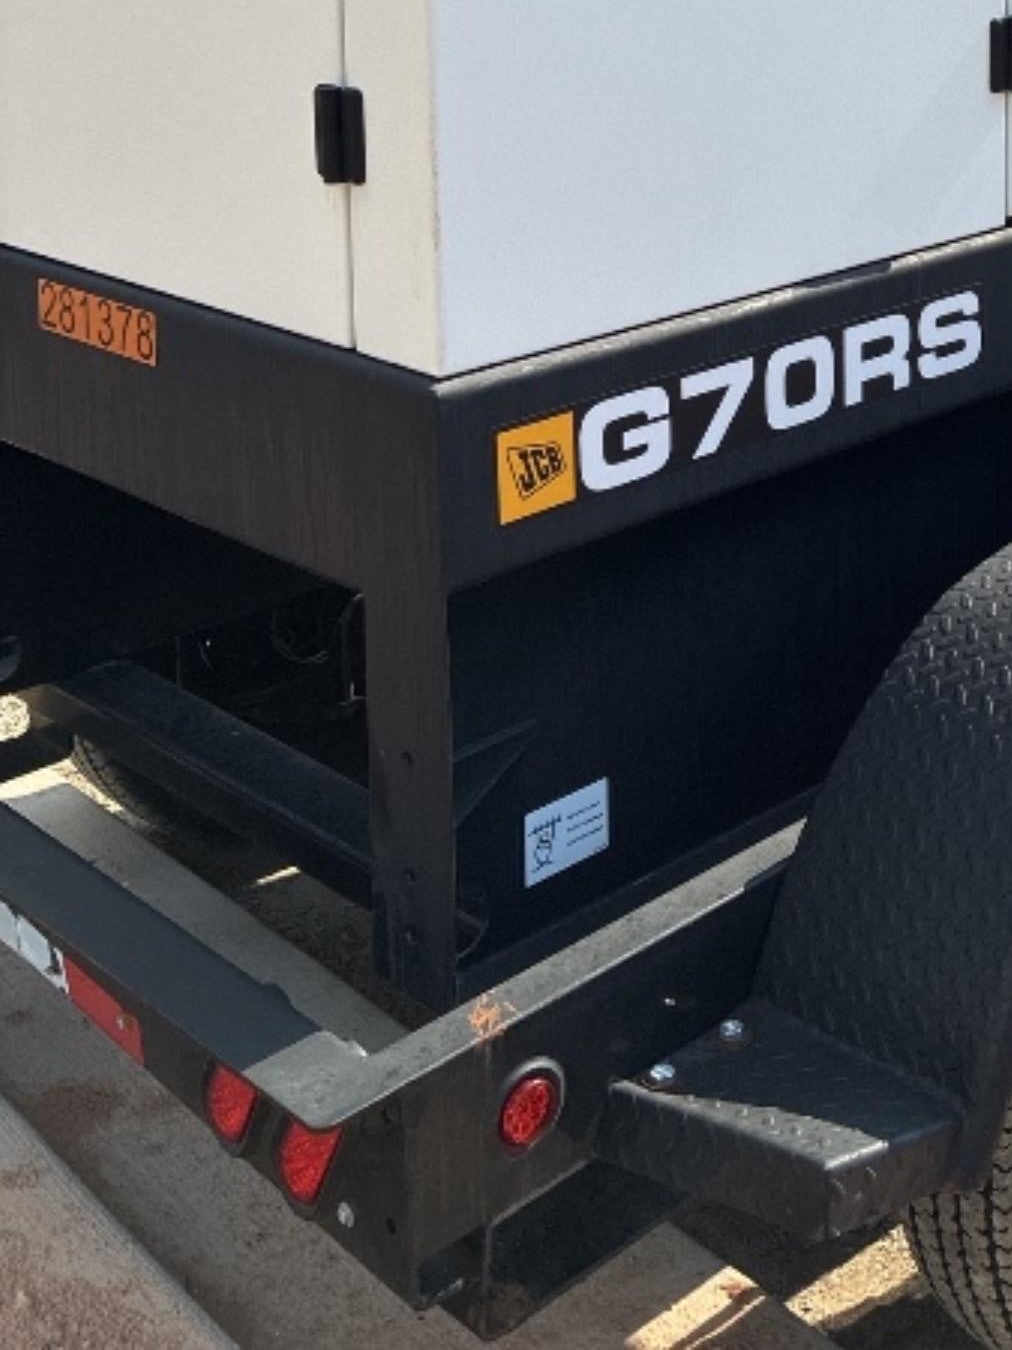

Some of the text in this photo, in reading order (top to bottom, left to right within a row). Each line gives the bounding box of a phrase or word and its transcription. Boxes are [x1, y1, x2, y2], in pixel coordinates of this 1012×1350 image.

[41, 280, 154, 360] 281378
[578, 290, 982, 494] G70RS
[517, 445, 562, 493] JCB
